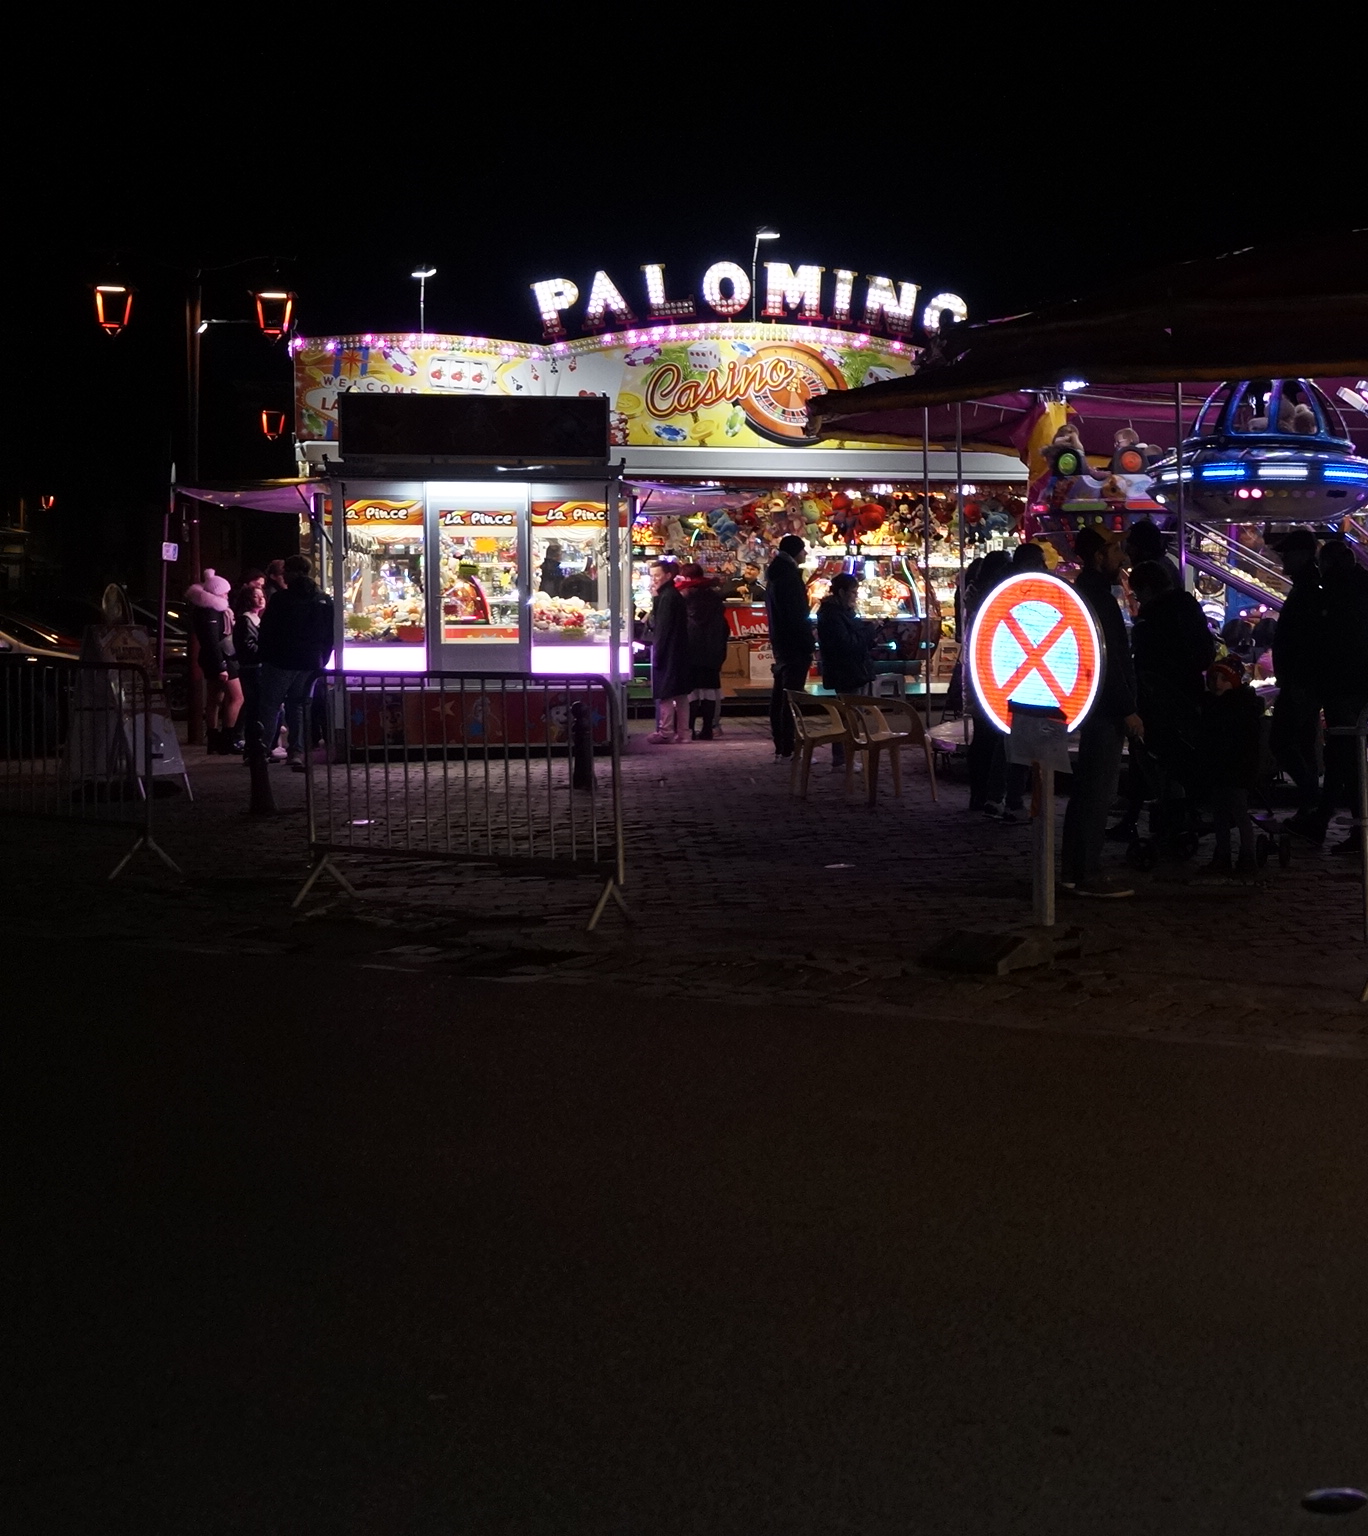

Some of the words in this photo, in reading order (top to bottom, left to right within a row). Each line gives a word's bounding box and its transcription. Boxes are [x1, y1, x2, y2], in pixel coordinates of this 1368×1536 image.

[645, 357, 794, 420] Casino
[345, 508, 359, 519] a
[365, 507, 408, 520] Pince
[445, 513, 464, 525] La
[471, 512, 513, 525] Pince
[547, 508, 566, 520] La
[573, 508, 609, 521] Pinc
